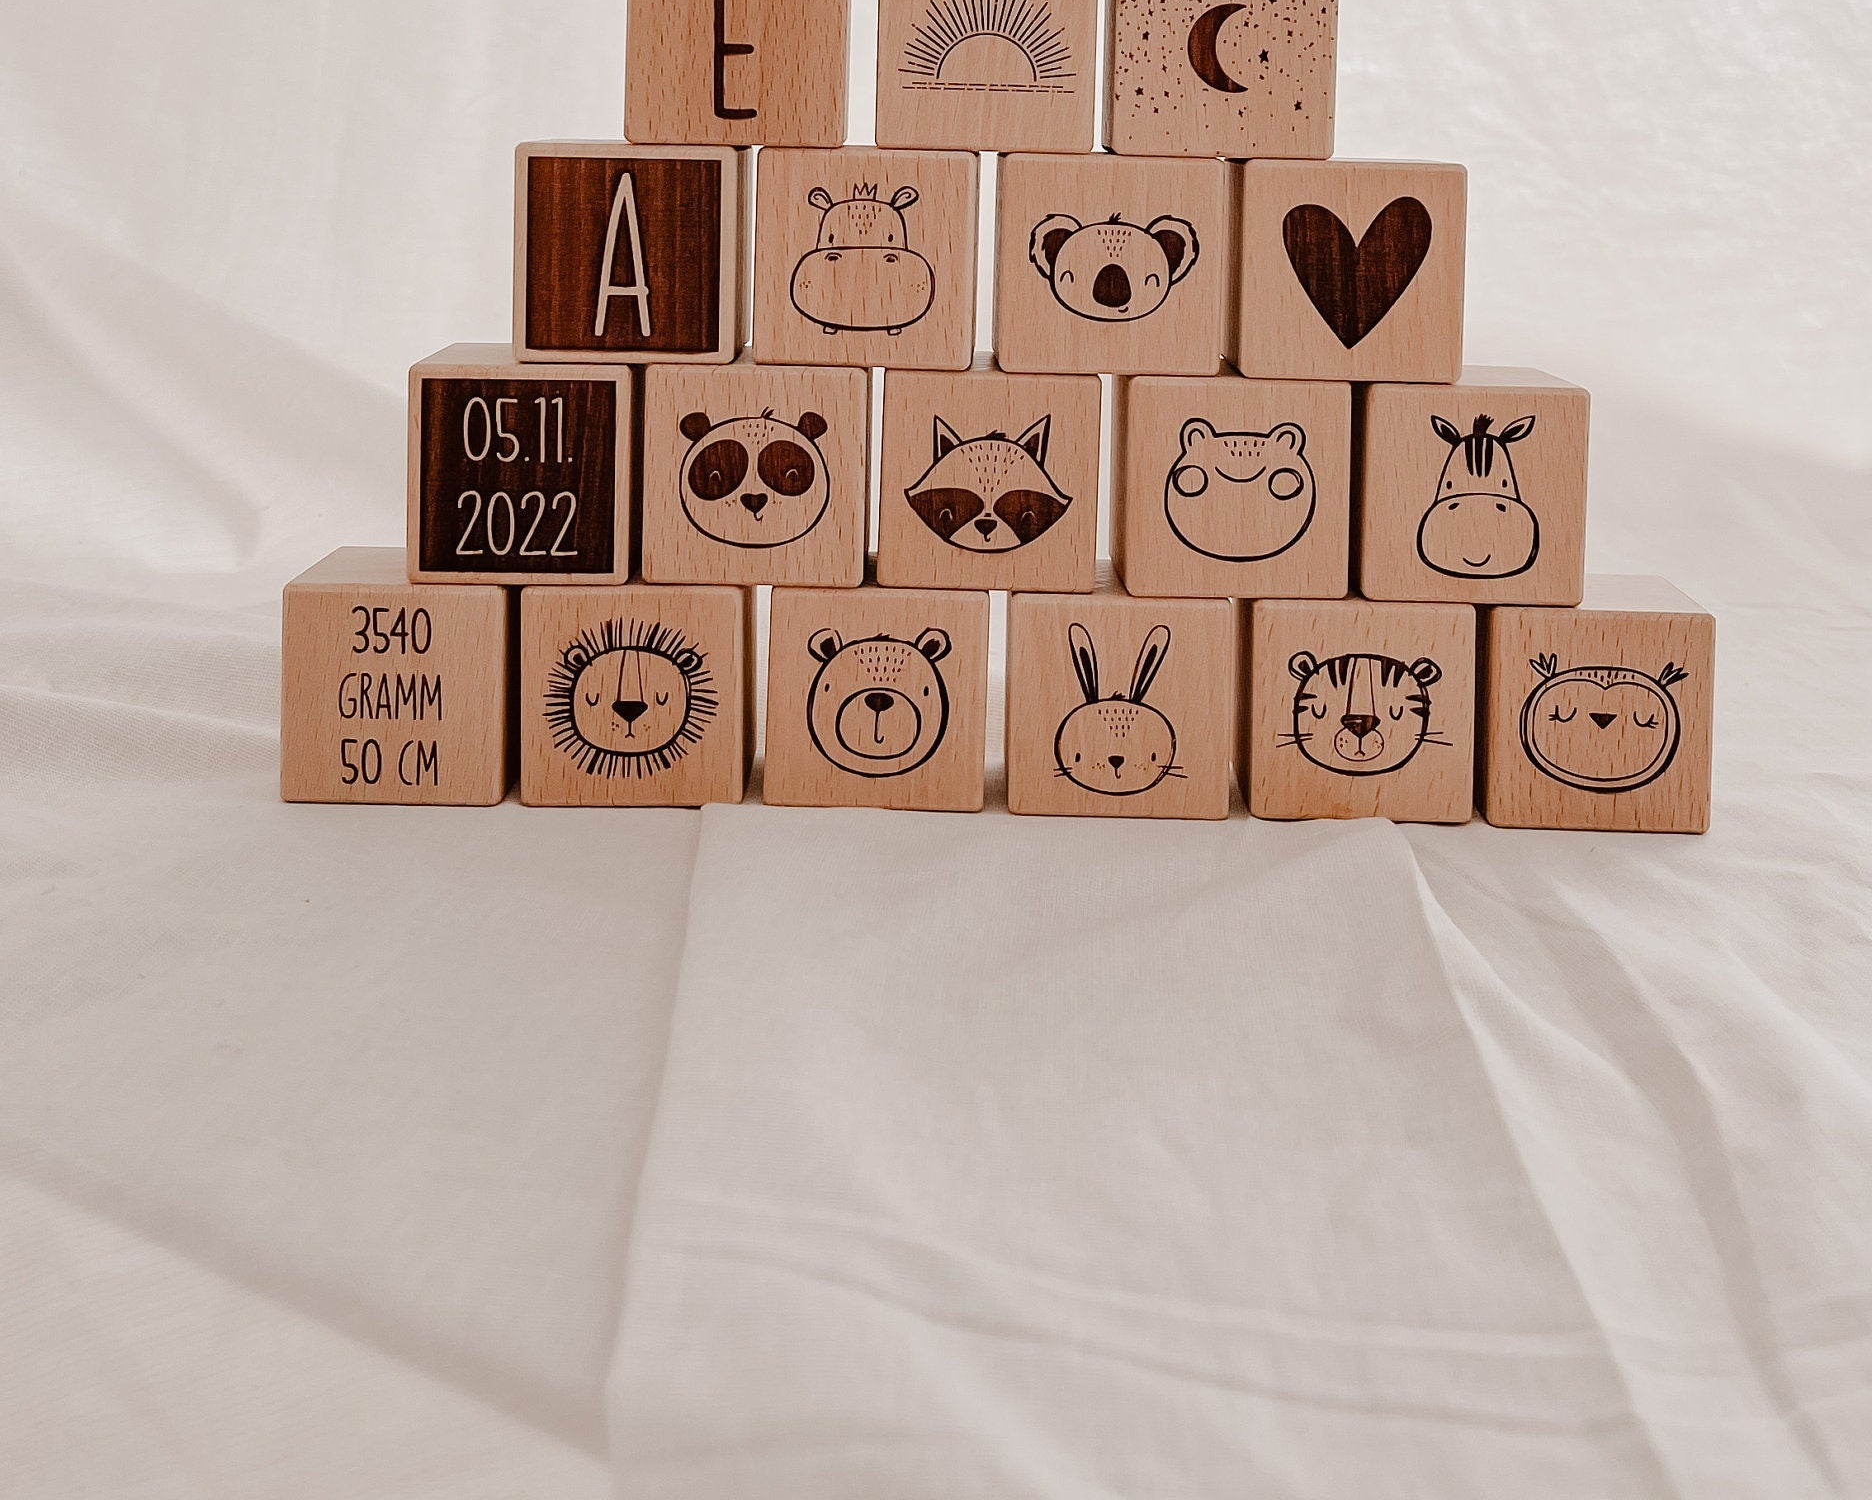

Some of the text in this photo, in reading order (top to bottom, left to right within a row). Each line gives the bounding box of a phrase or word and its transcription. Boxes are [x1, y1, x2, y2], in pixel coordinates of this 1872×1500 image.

[594, 172, 650, 337] A
[463, 396, 574, 463] 05.11.
[455, 490, 578, 556] 2022
[351, 605, 432, 655] 3540
[338, 672, 443, 721] GRAMM
[340, 738, 439, 786] 50 CM
